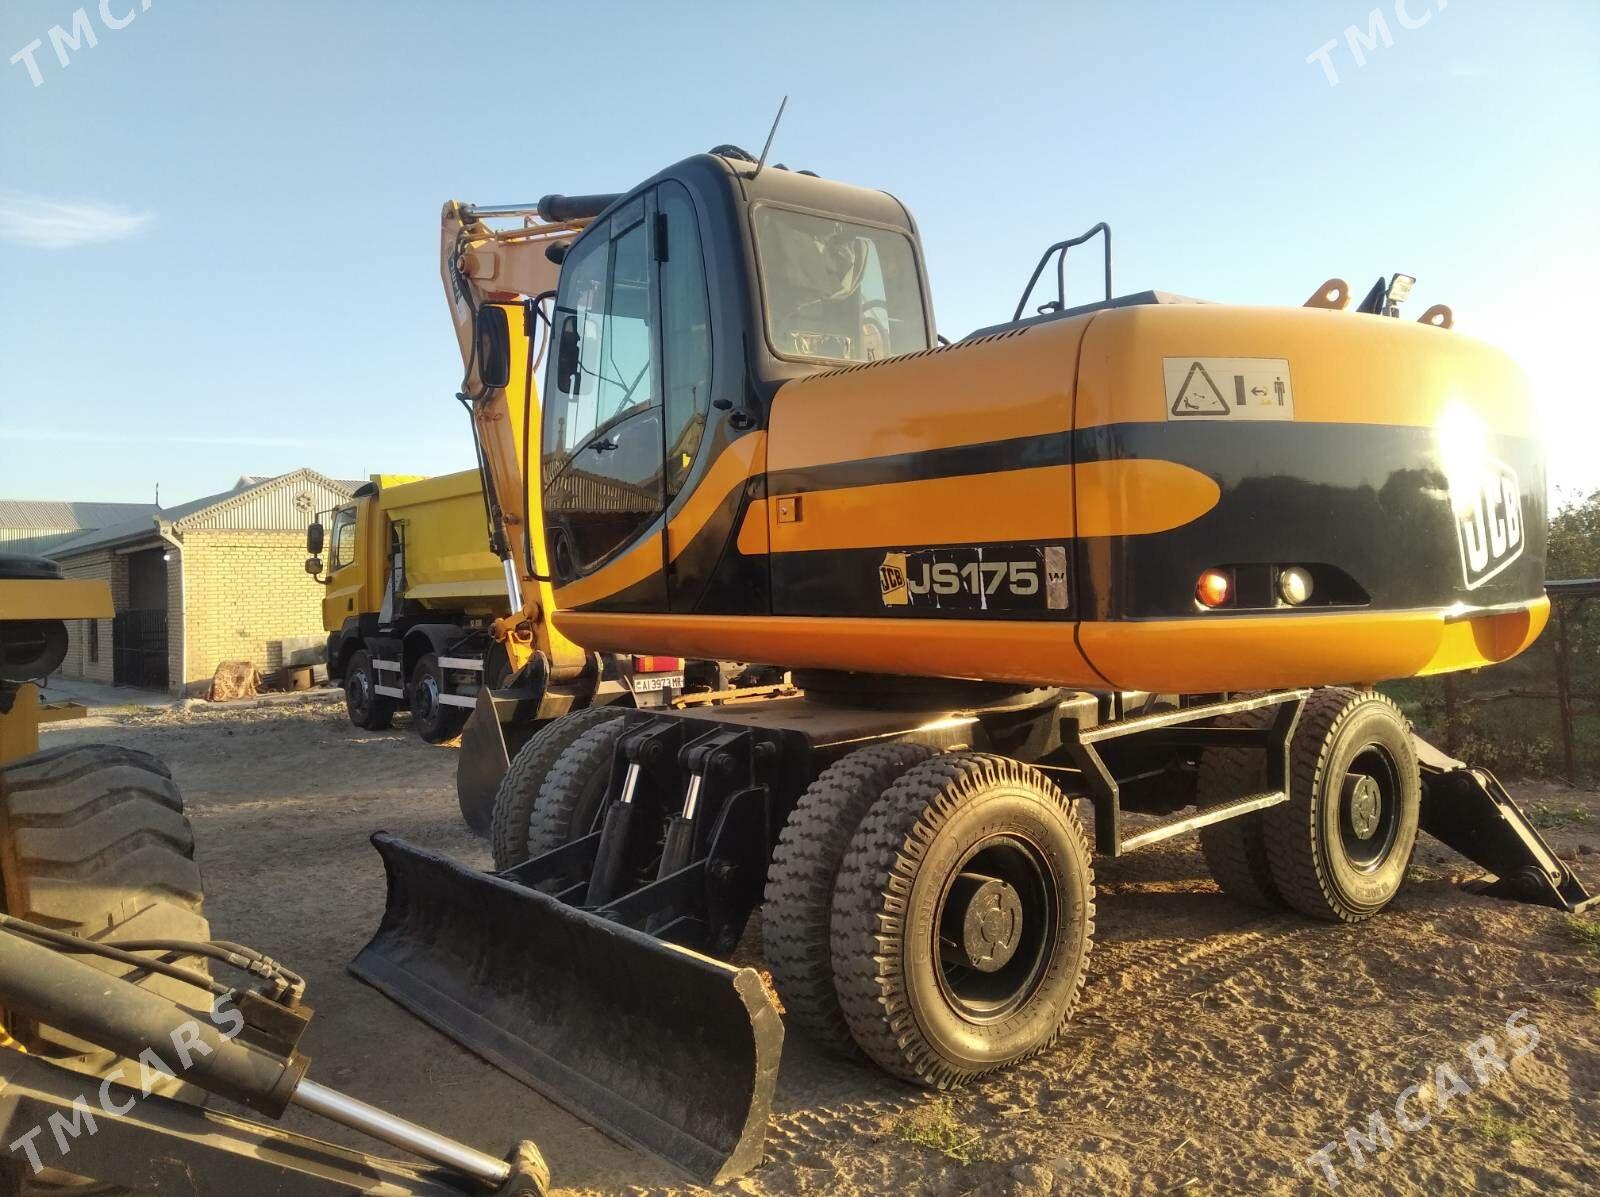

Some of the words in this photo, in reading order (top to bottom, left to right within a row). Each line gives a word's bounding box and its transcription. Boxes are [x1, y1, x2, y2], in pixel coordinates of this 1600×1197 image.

[1455, 462, 1521, 572] JCB
[880, 566, 904, 592] JCB
[909, 561, 1039, 595] JS175
